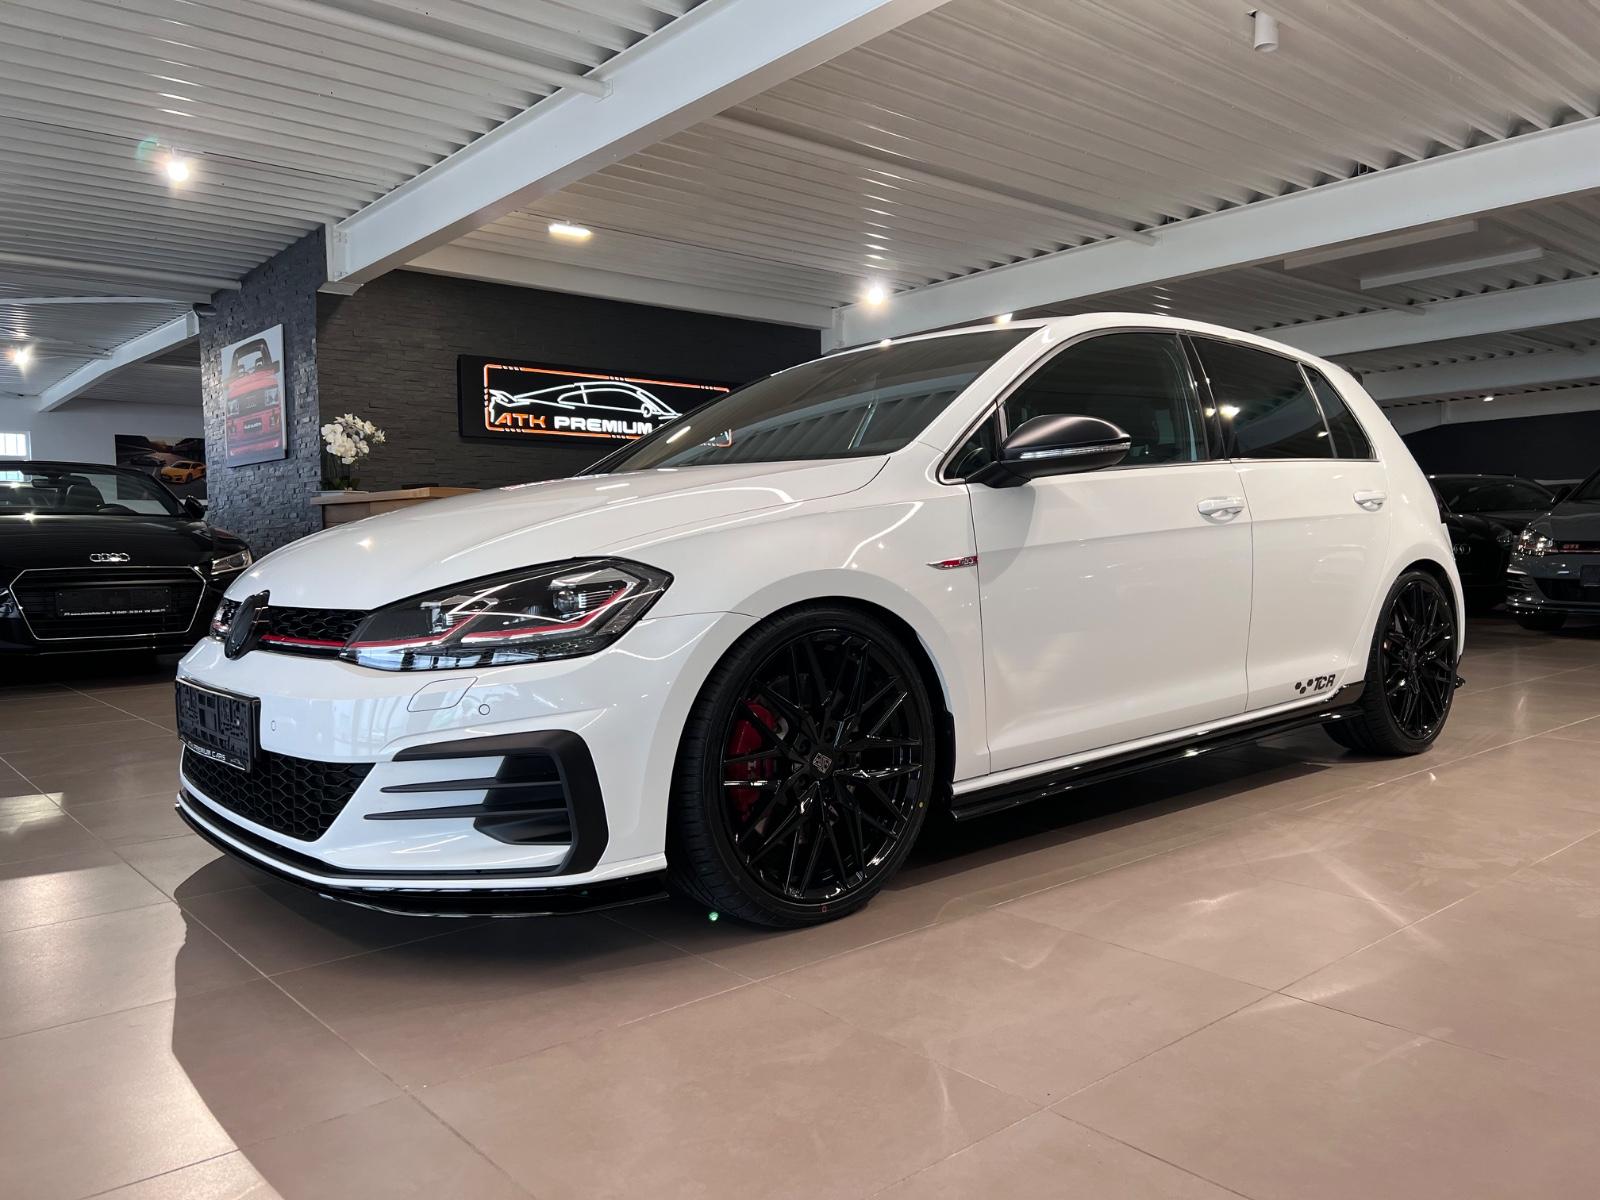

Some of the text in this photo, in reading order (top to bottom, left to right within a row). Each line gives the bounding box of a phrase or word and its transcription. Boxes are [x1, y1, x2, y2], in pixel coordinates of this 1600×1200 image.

[494, 412, 653, 435] ATK PREMIUM
[1313, 674, 1336, 691] TCR
